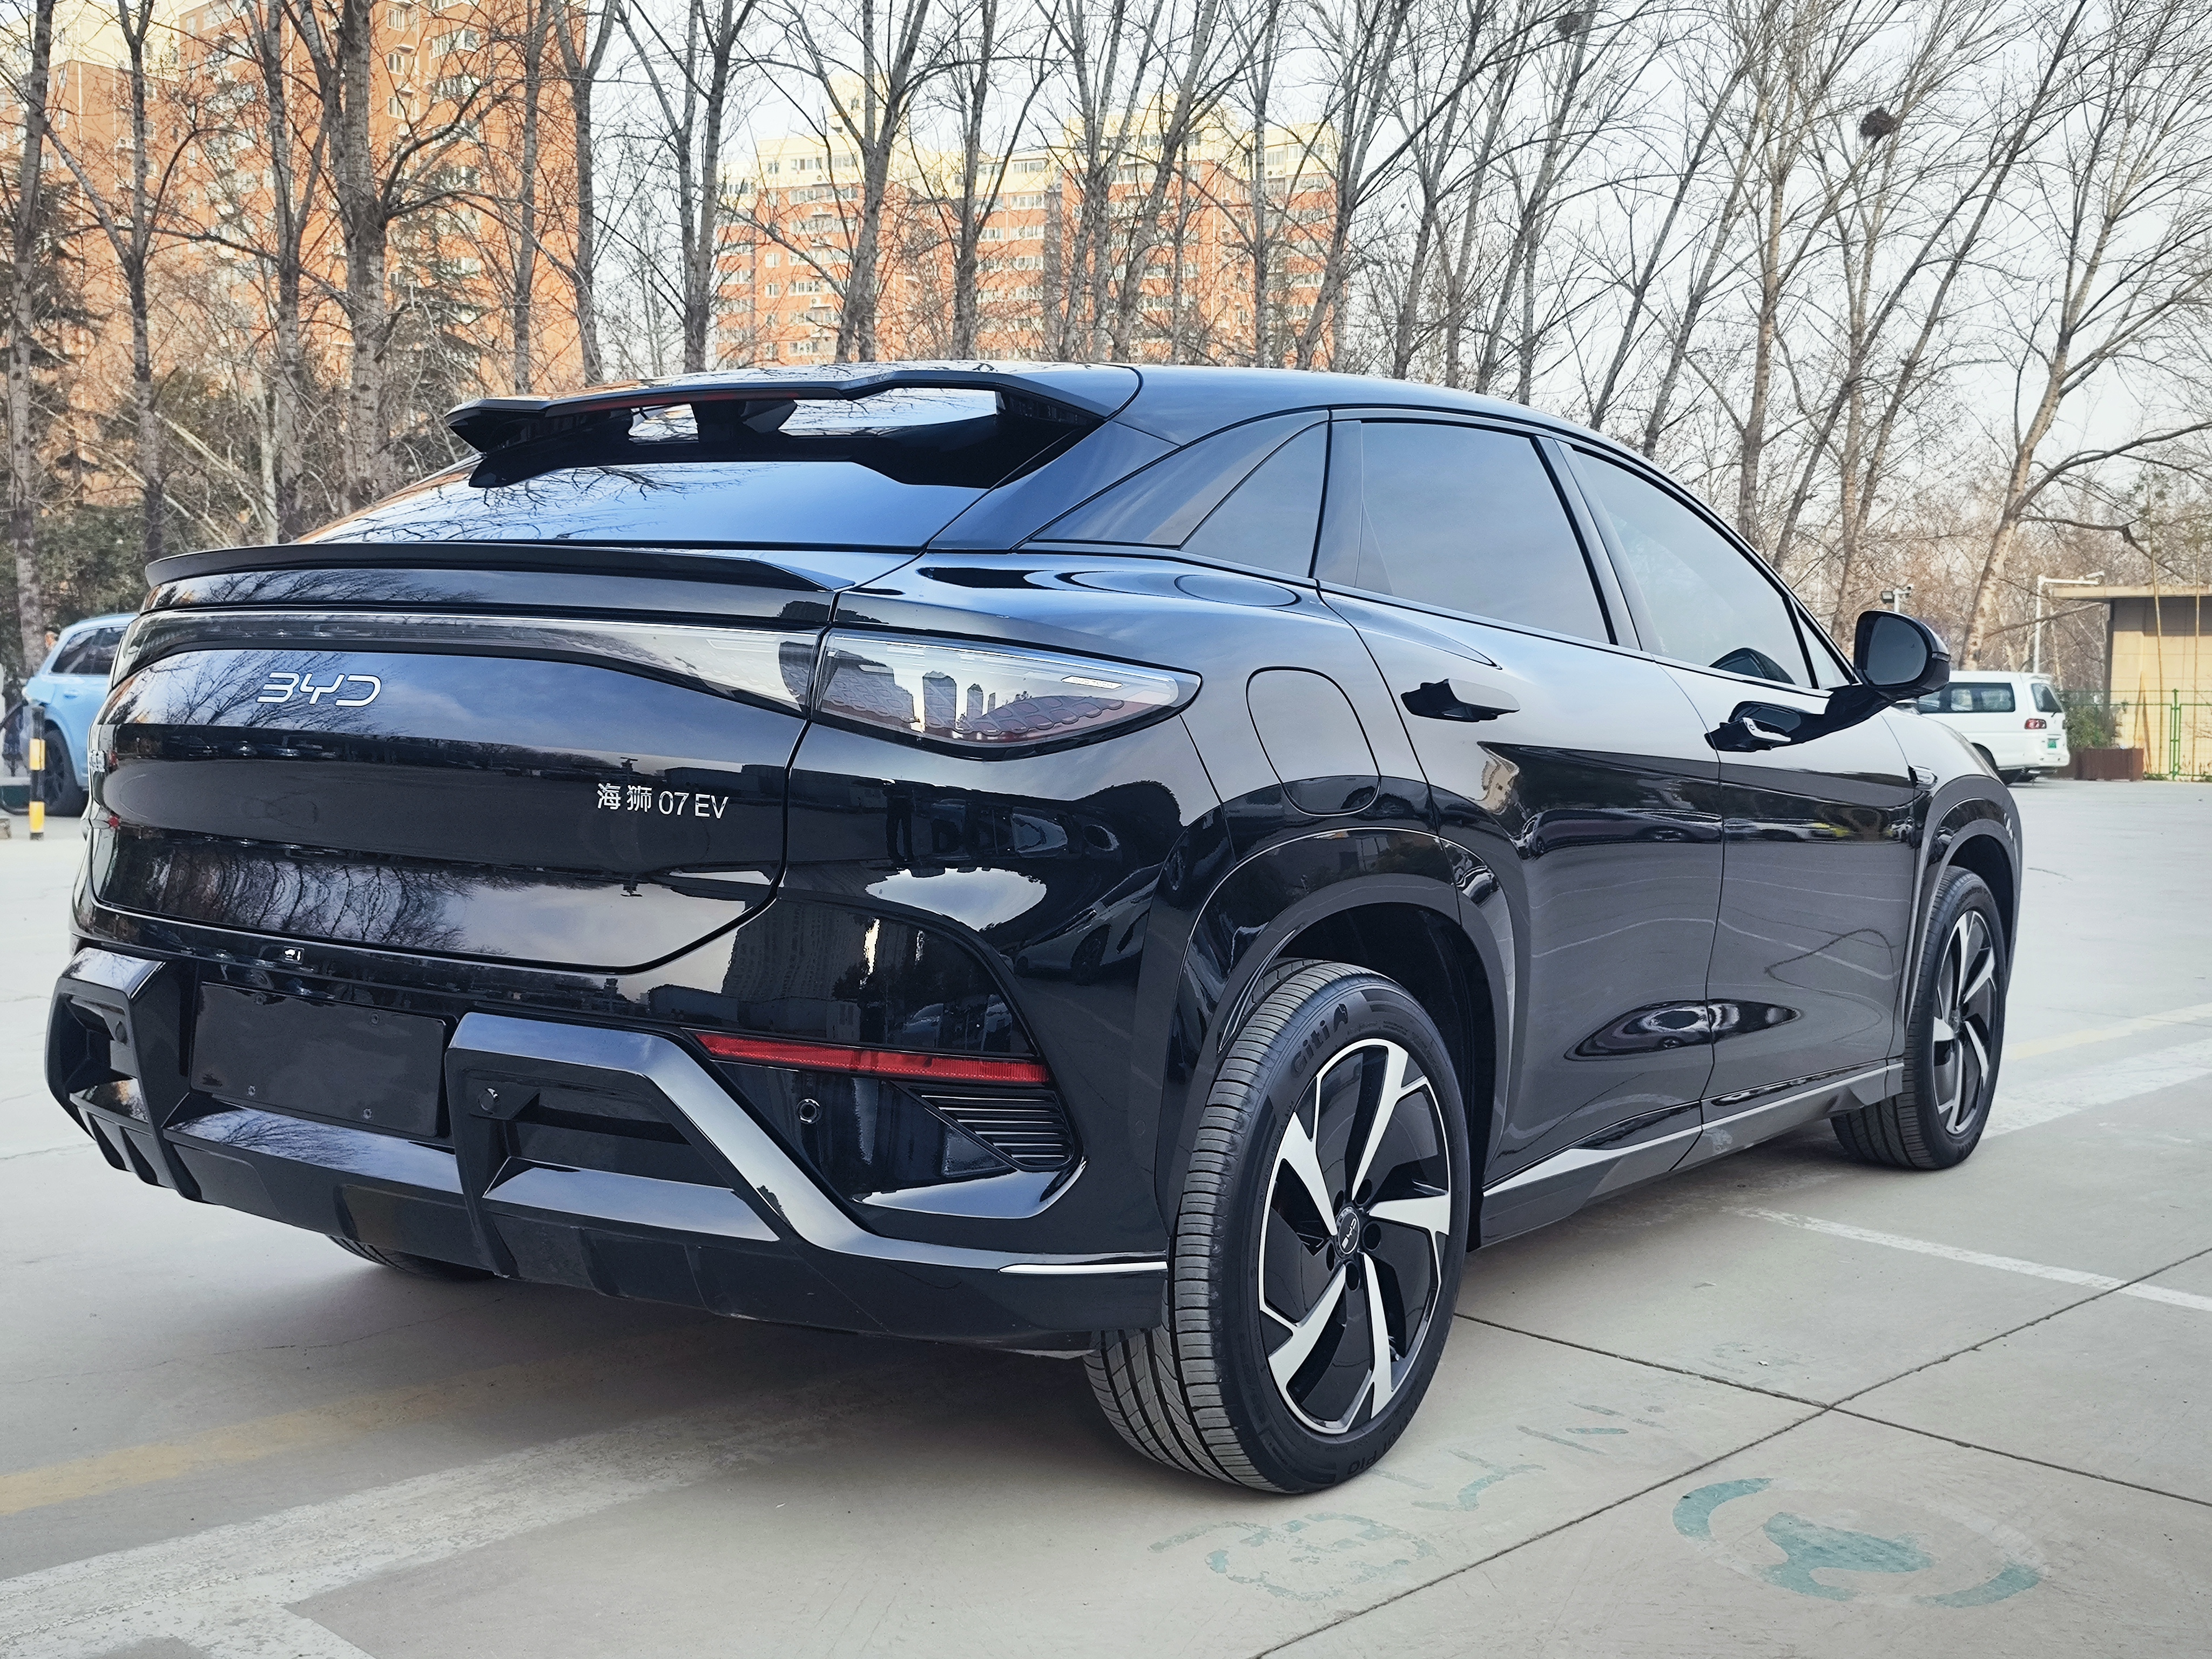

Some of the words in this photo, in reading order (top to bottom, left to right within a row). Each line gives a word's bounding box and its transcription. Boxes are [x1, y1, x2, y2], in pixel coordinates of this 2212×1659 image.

[257, 671, 382, 707] BYD
[596, 783, 652, 813] 海狮
[1290, 1020, 1330, 1078] Giti
[1341, 1218, 1357, 1249] BYD
